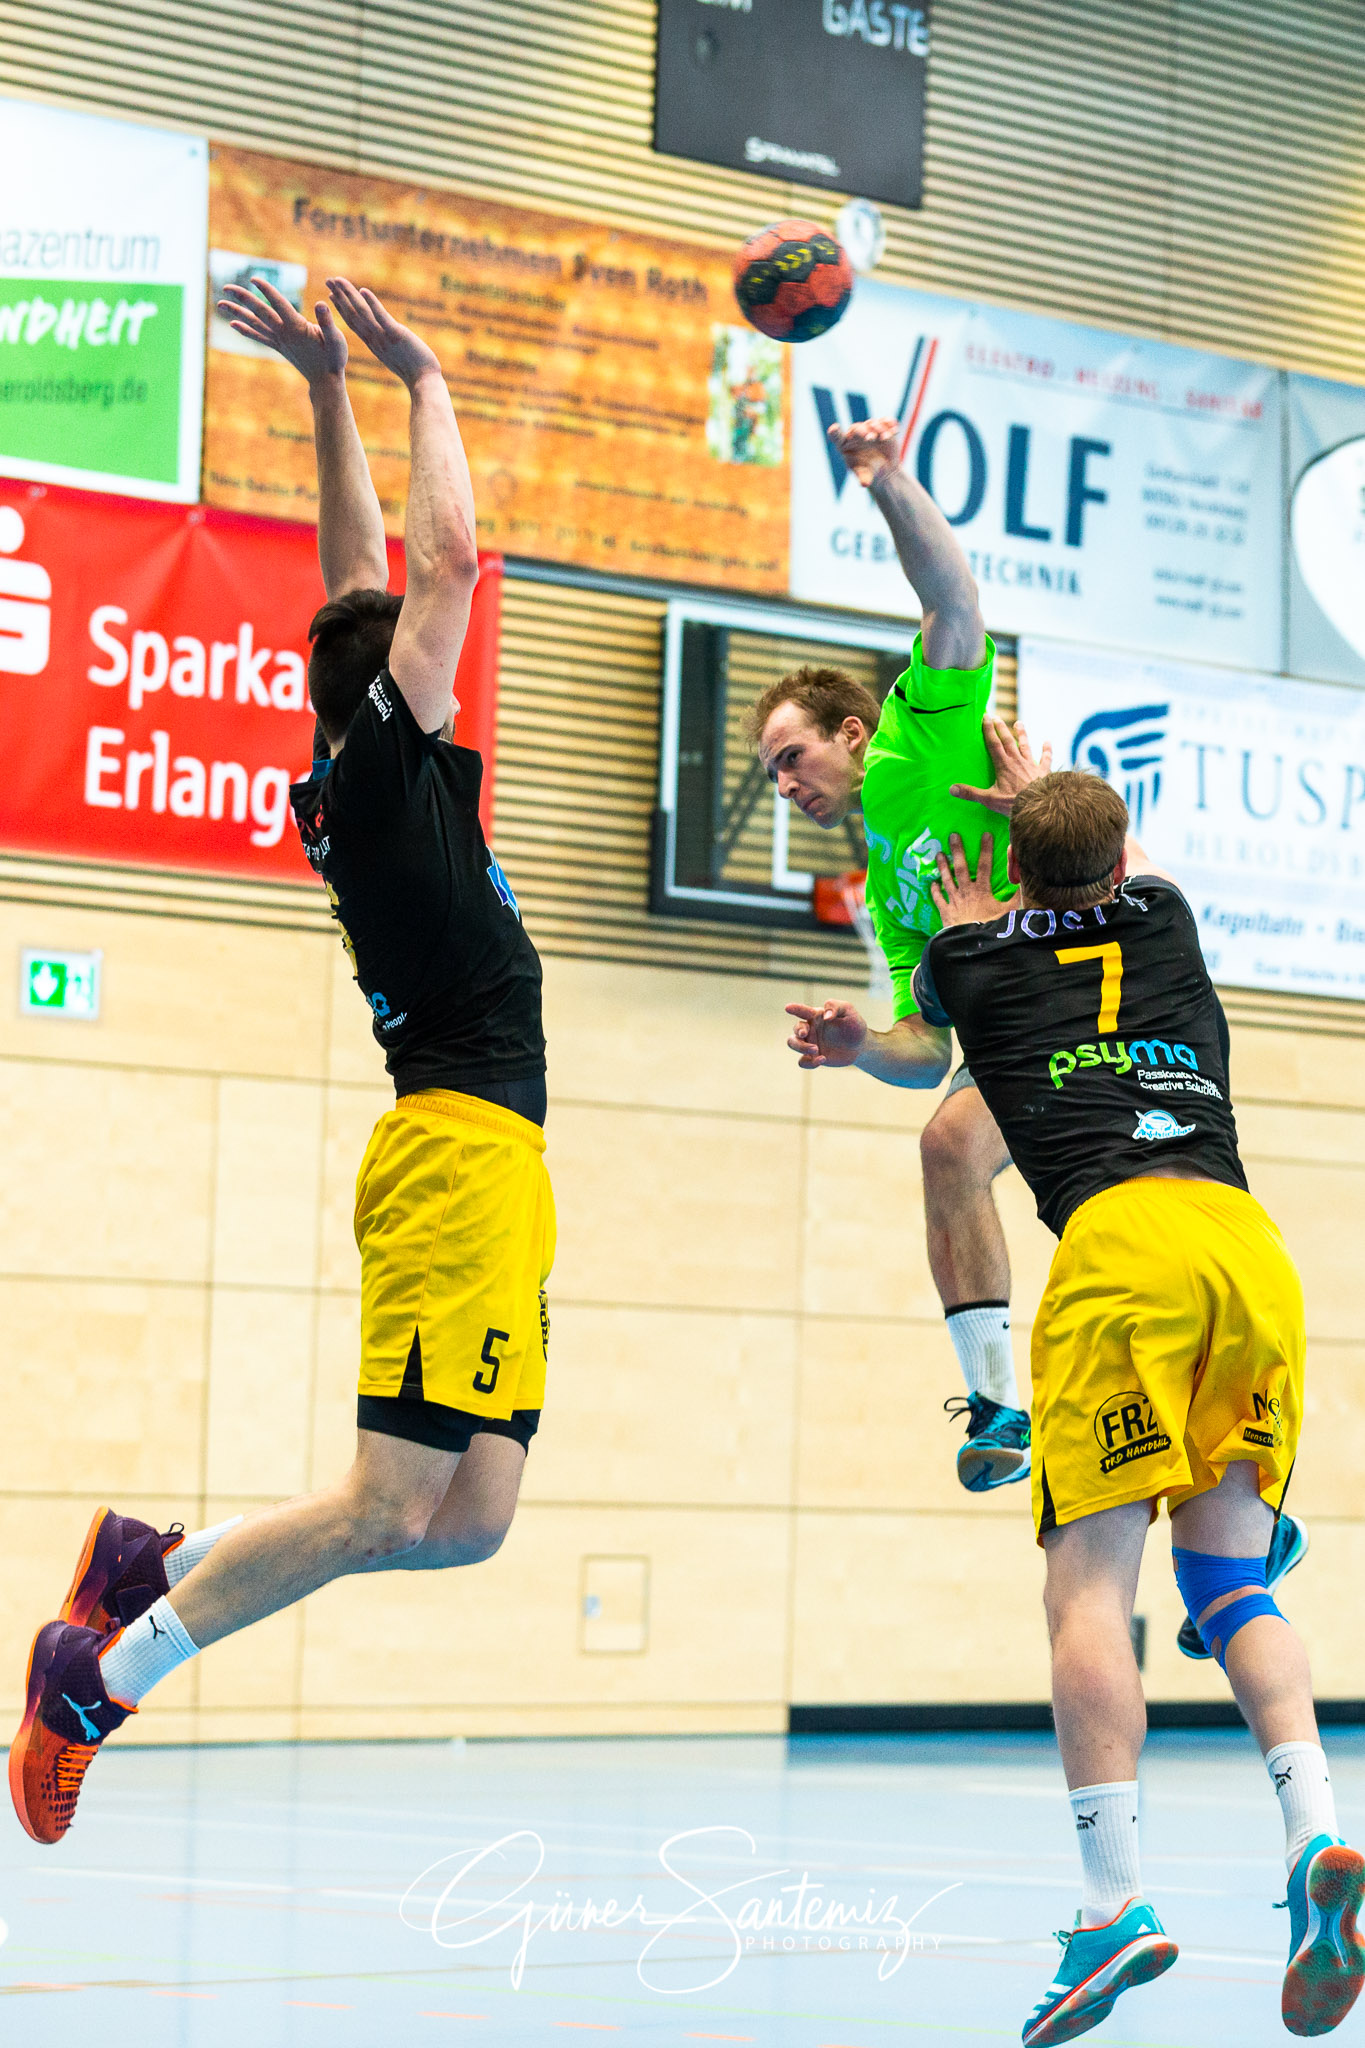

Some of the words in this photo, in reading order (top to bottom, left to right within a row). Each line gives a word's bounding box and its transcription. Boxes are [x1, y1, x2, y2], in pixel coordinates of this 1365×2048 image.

[88, 605, 317, 710] Sparka
[1054, 941, 1124, 1034] 7
[1048, 1038, 1199, 1090] psyma
[1139, 1080, 1184, 1092] Creative
[472, 1327, 511, 1395] 5
[1104, 1452, 1125, 1471] PRO
